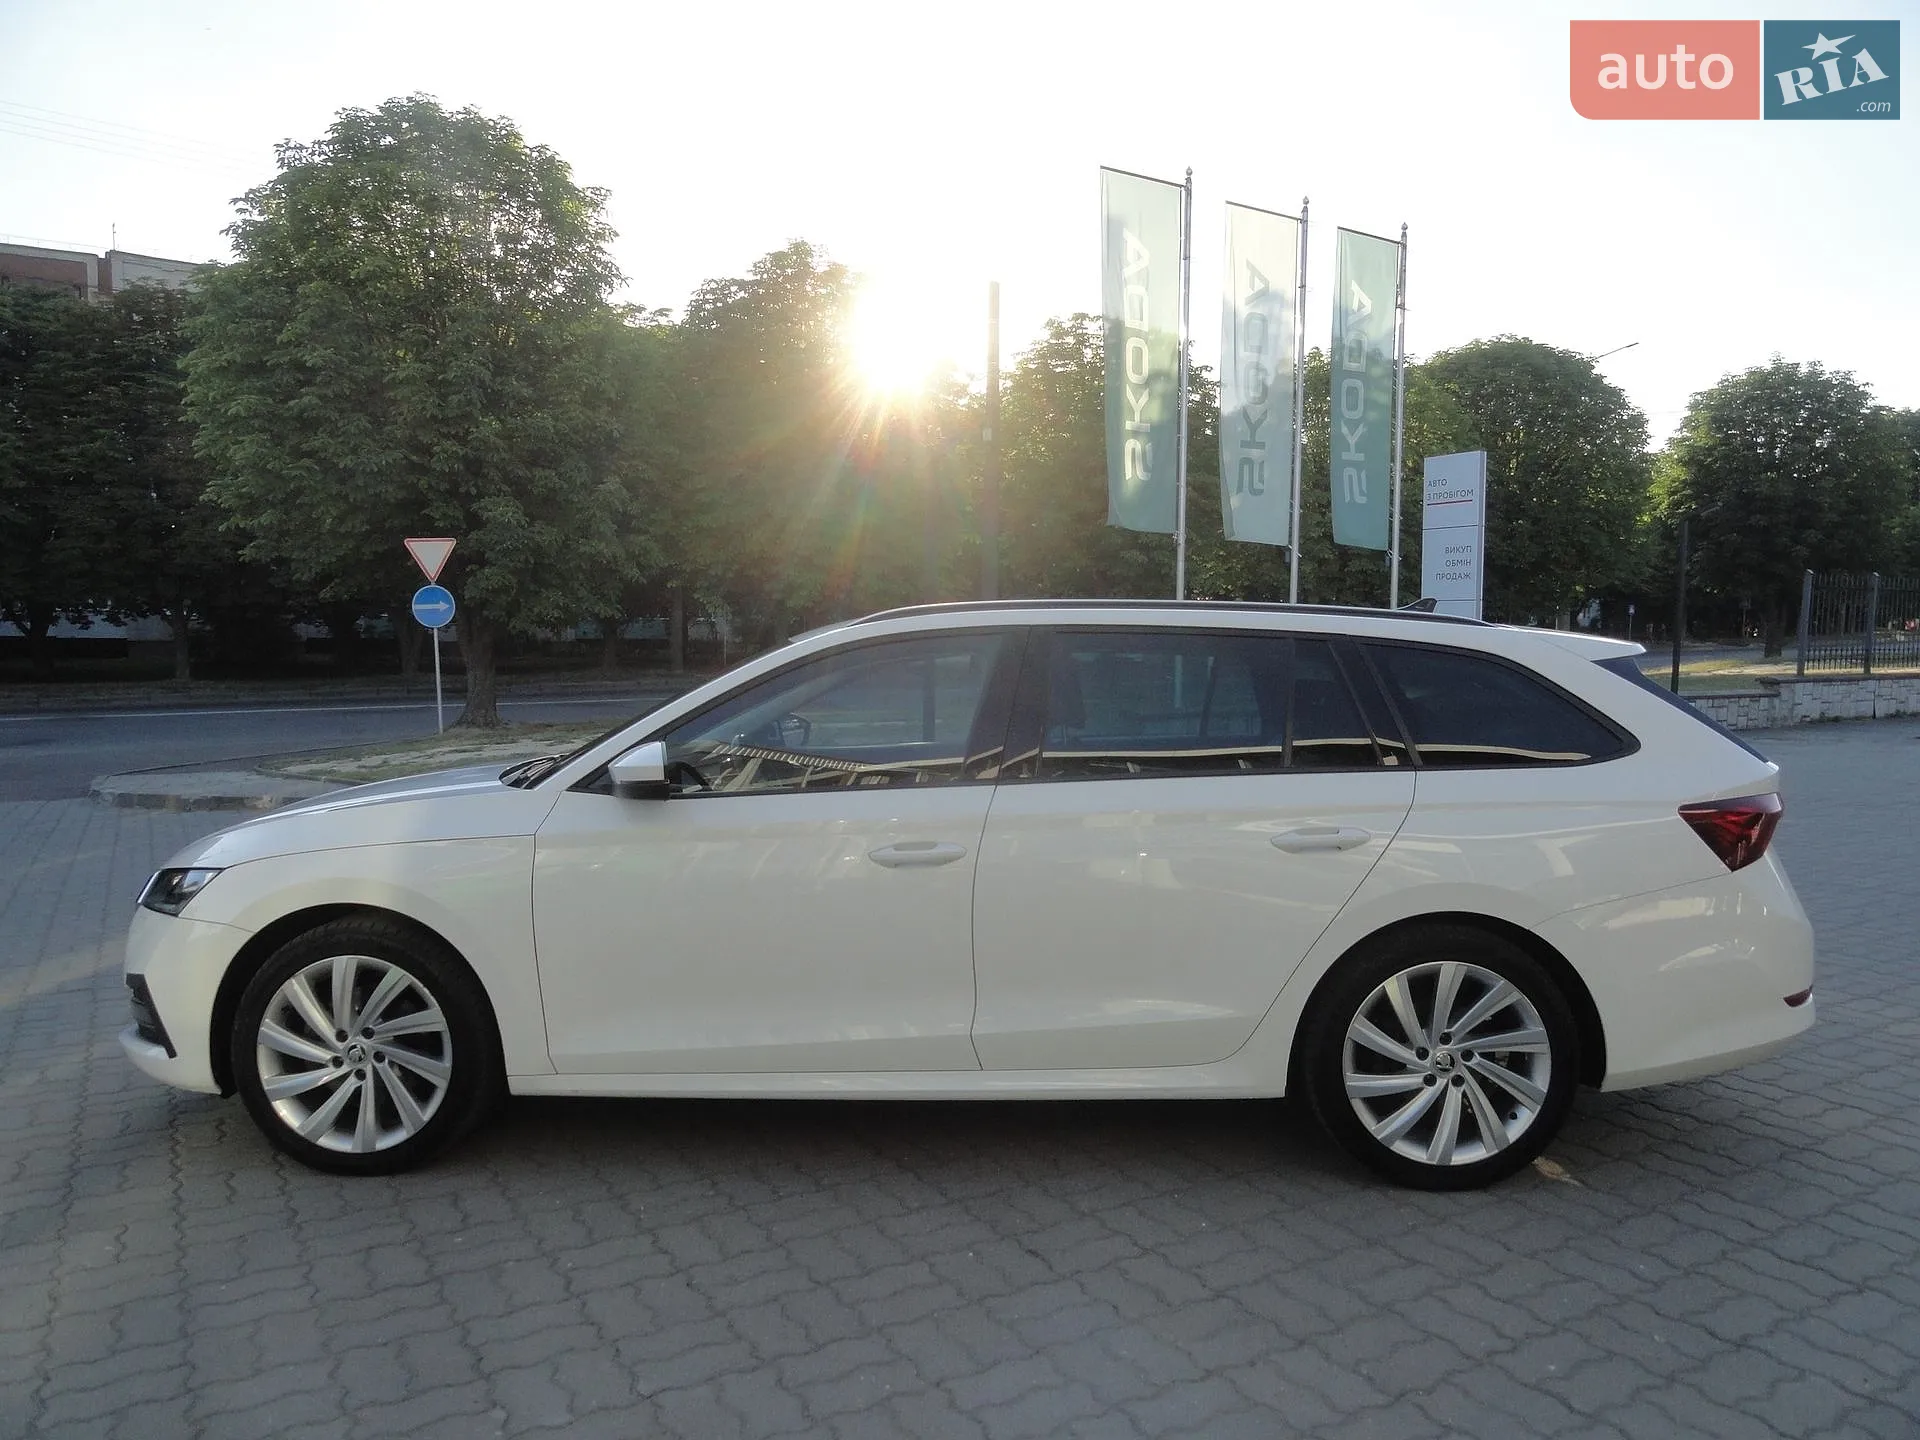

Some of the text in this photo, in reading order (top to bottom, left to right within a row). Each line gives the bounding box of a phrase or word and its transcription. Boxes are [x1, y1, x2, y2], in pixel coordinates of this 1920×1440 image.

[1427, 478, 1448, 488] АВТО
[1432, 489, 1474, 500] ПРОБІГОМ
[1445, 545, 1472, 554] ВИКУП
[1445, 559, 1471, 568] ОБМІН
[1435, 572, 1471, 582] ПРОДАЖ
